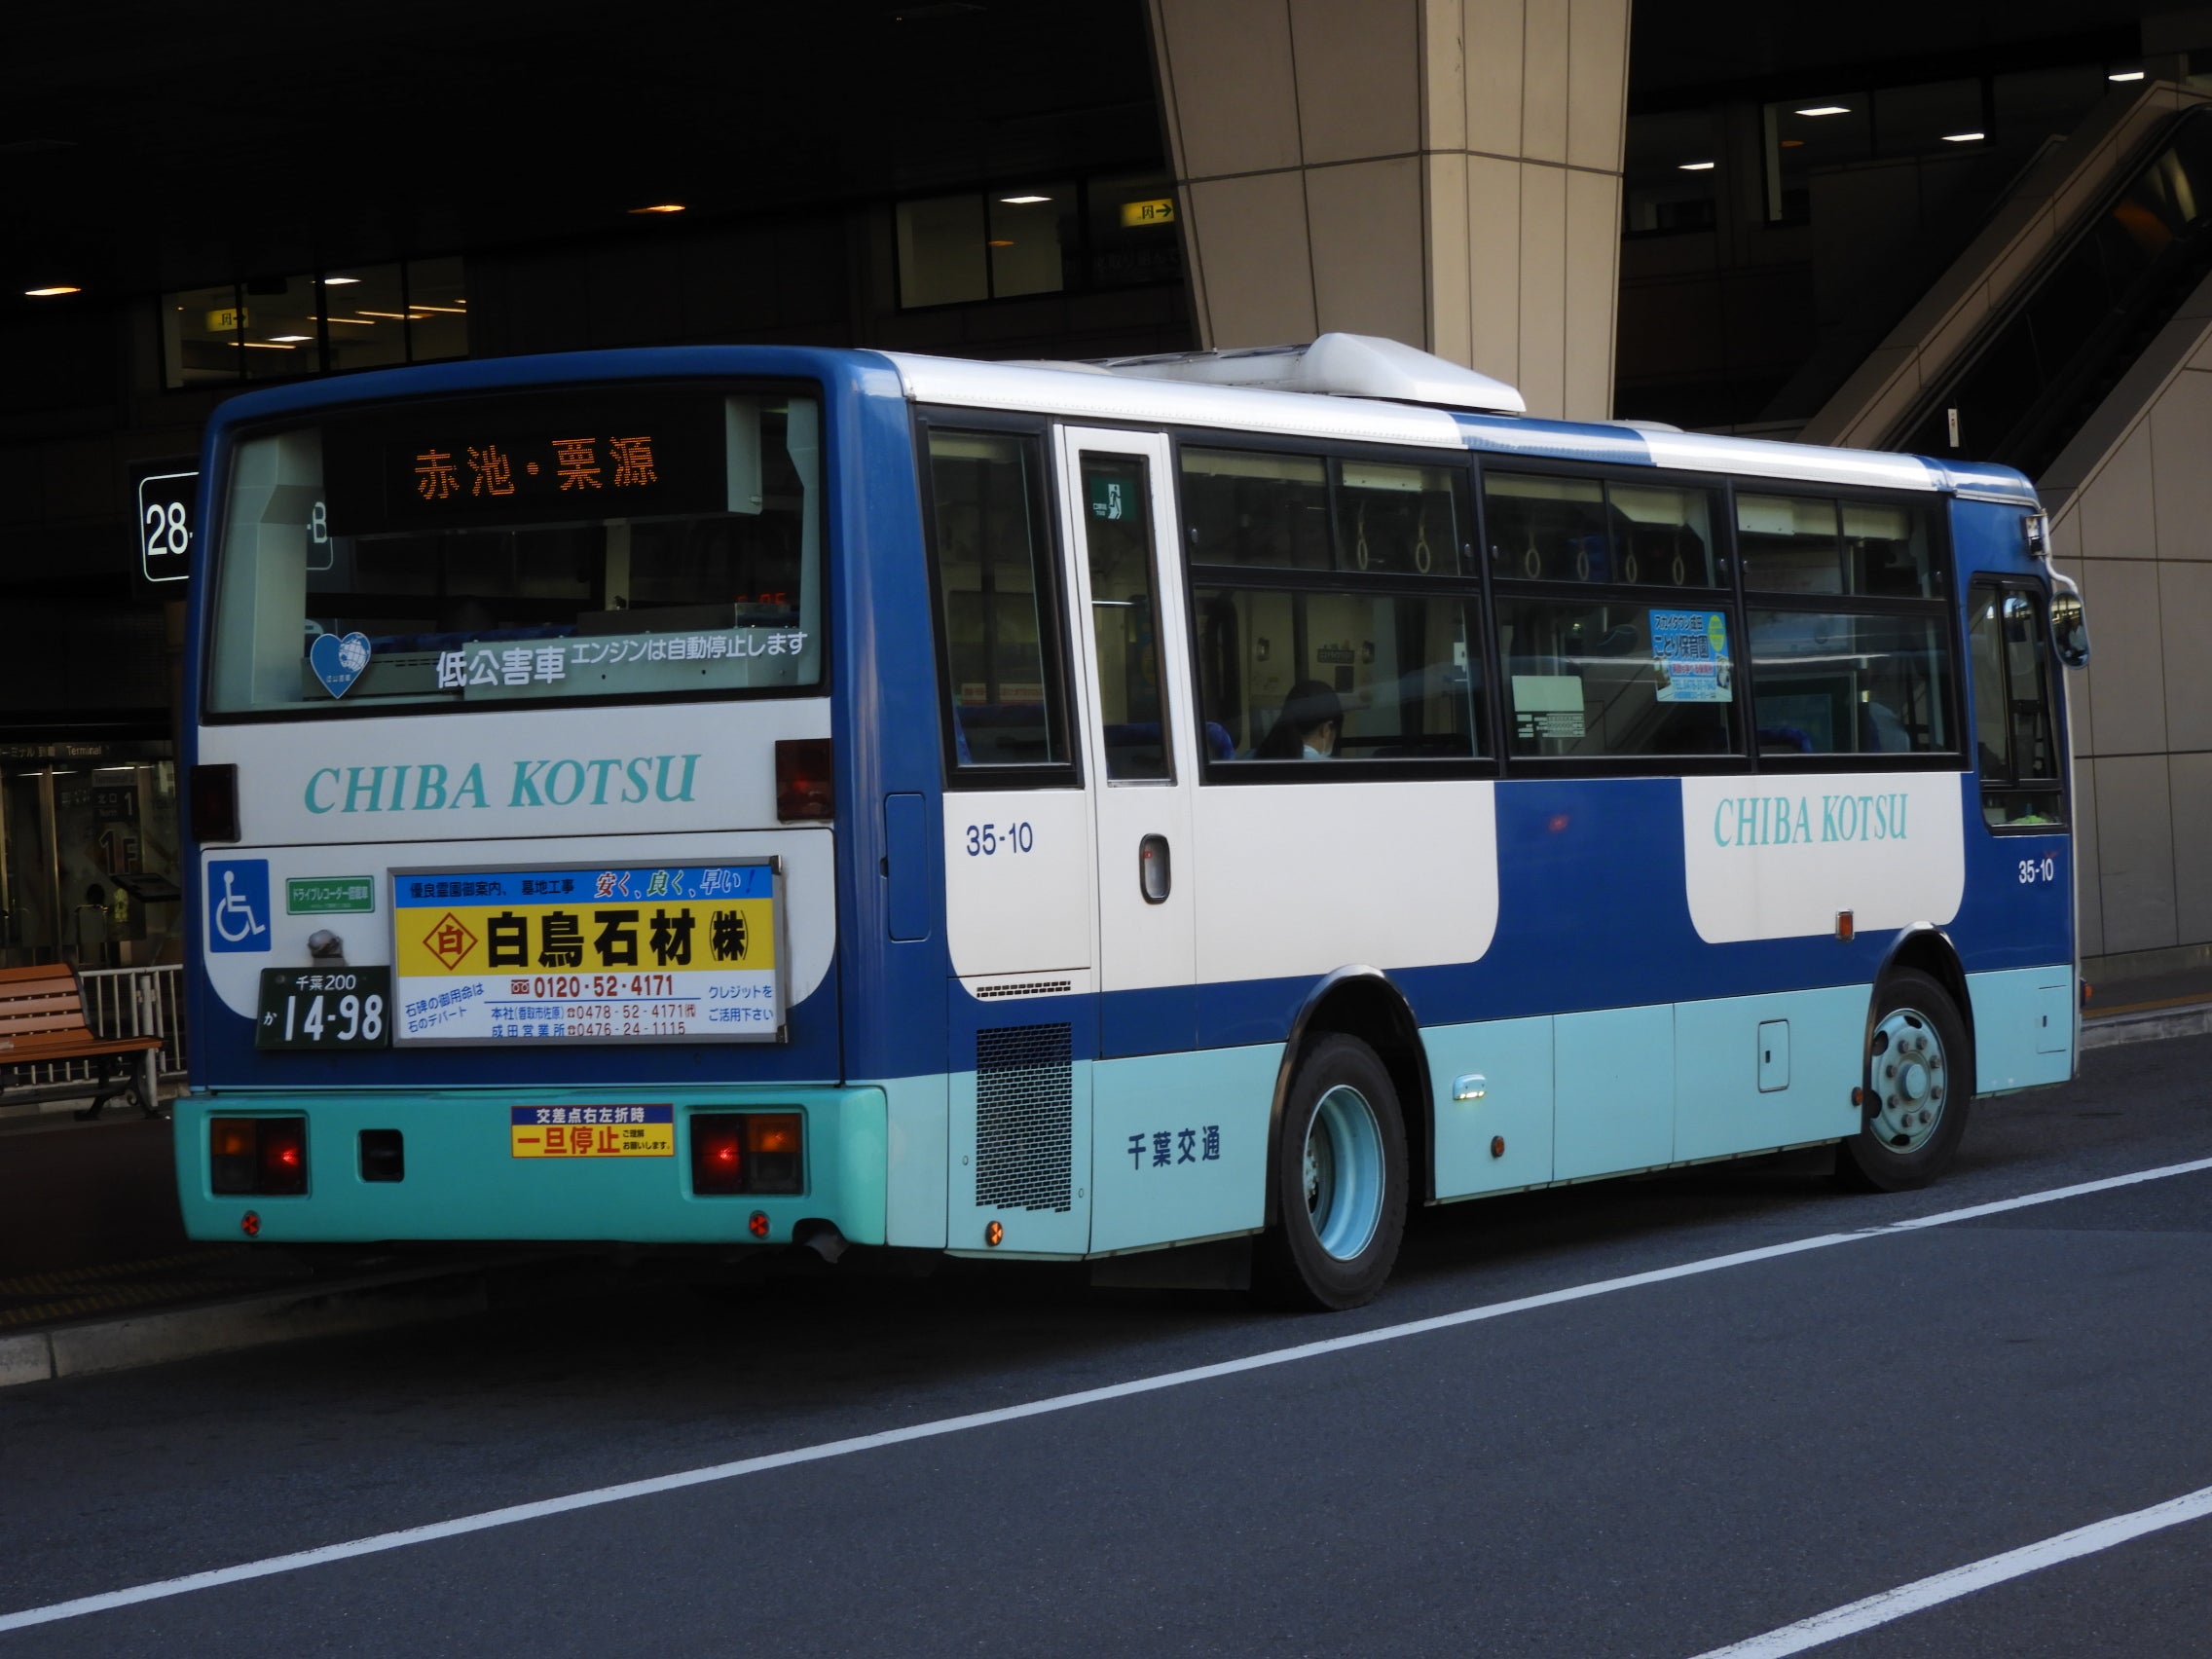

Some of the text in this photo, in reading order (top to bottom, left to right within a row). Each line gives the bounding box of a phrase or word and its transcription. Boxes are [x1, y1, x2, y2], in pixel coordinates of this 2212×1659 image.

[415, 436, 657, 499] 赤池・栗源
[571, 631, 808, 664] エンジンは自動停止します
[436, 645, 567, 690] 低公害車
[304, 754, 702, 815] CHIBA KOTSU
[1714, 793, 1908, 847] CHIBA KOTSU
[967, 822, 1033, 857] 35-10
[521, 879, 574, 896] 墓地工事
[2018, 858, 2053, 884] 35-10
[709, 985, 773, 1000] クレジットを
[263, 1012, 277, 1026] か
[285, 994, 383, 1041] 14-98
[709, 1008, 774, 1022] ご活用下さい
[536, 1107, 645, 1124] 交差点右左折時
[517, 1125, 621, 1155] 一旦停止
[1127, 1125, 1221, 1170] 千葉交通
